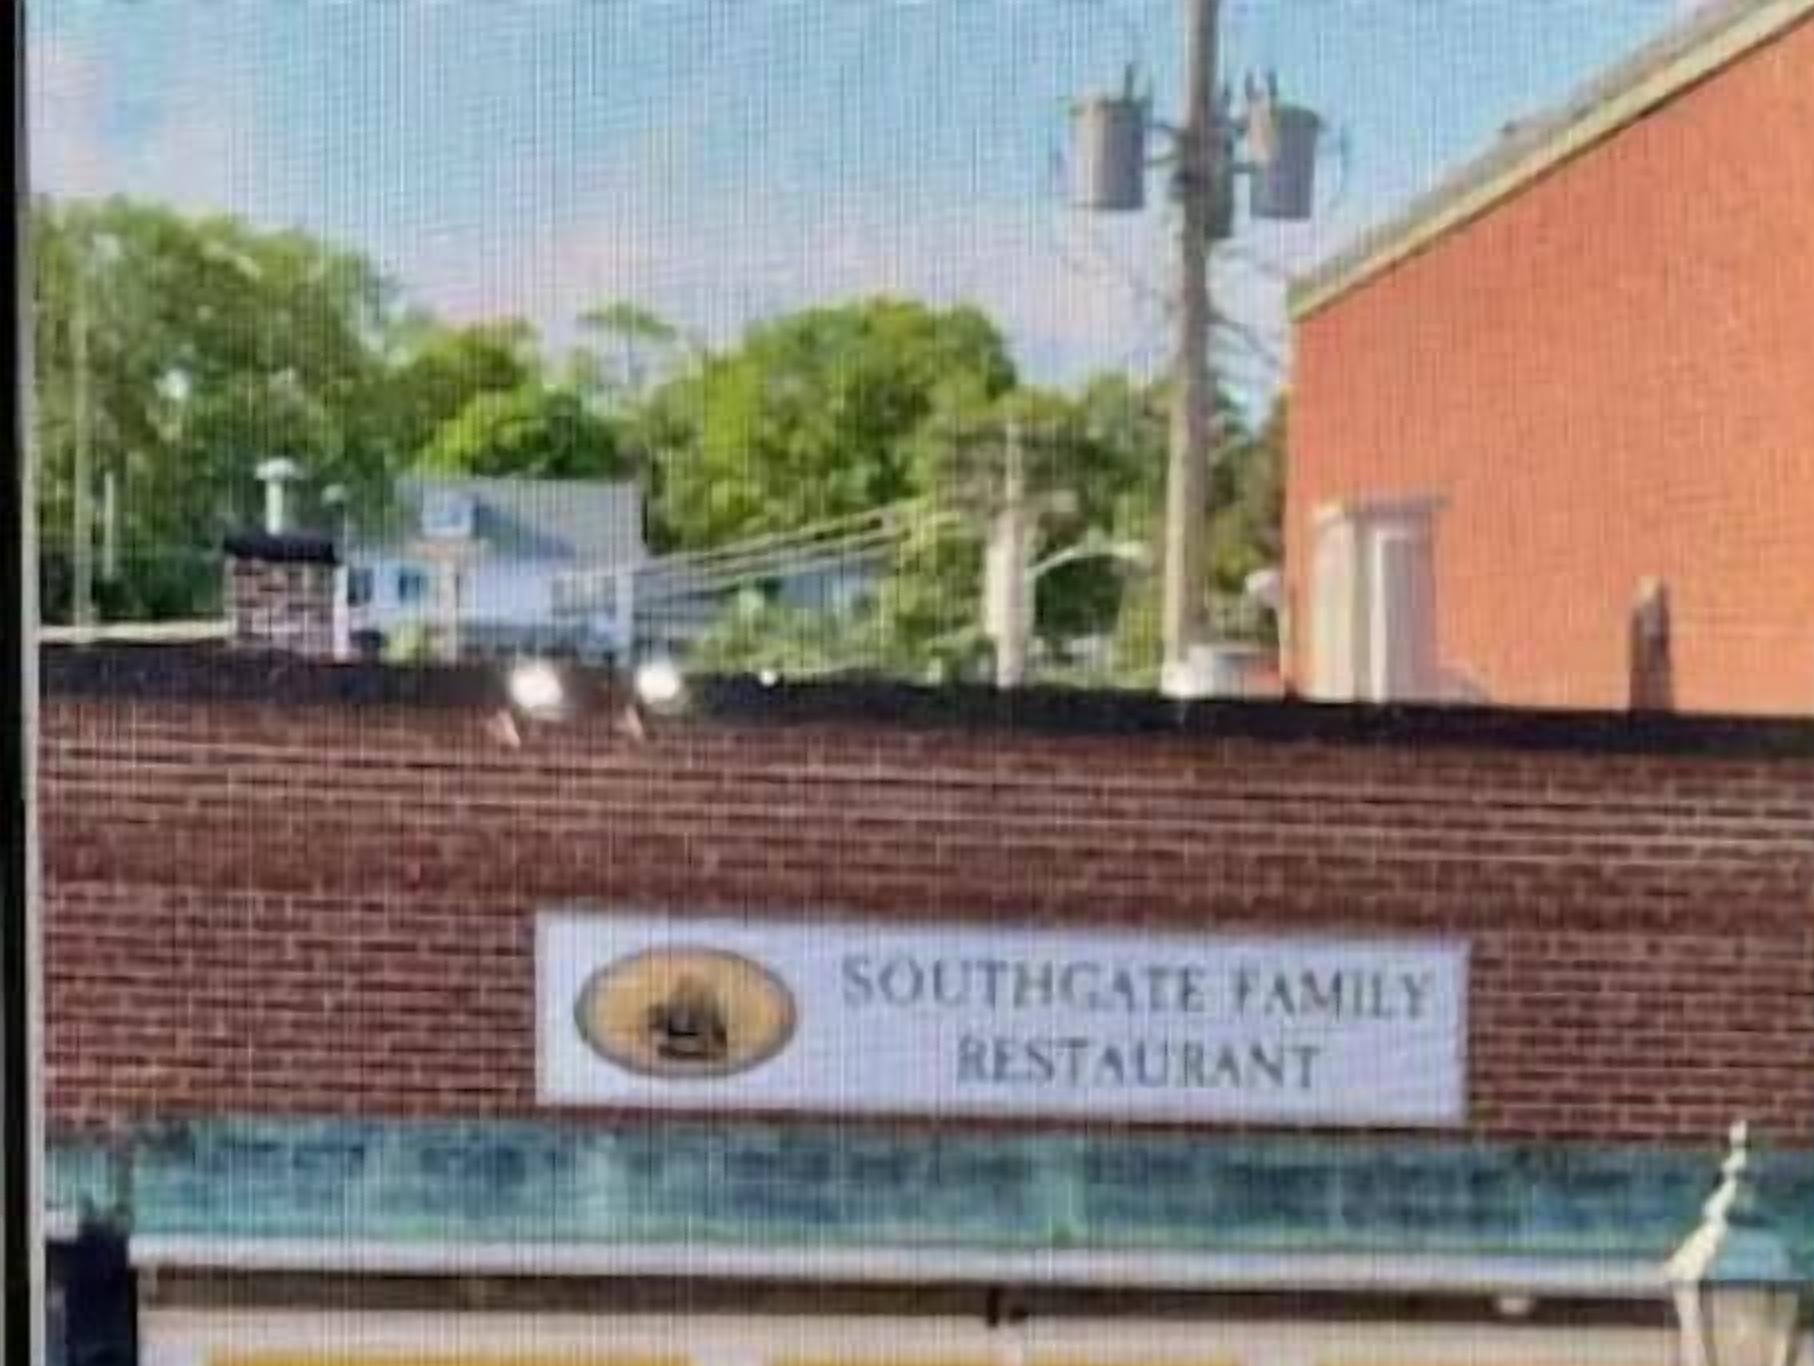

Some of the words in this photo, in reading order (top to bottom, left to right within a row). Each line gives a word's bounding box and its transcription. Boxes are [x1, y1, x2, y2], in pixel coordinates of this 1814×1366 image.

[842, 954, 1203, 1014] SOUTHGATE
[1235, 968, 1434, 1022] FAMILY
[958, 1034, 1320, 1092] RESTAURANT
